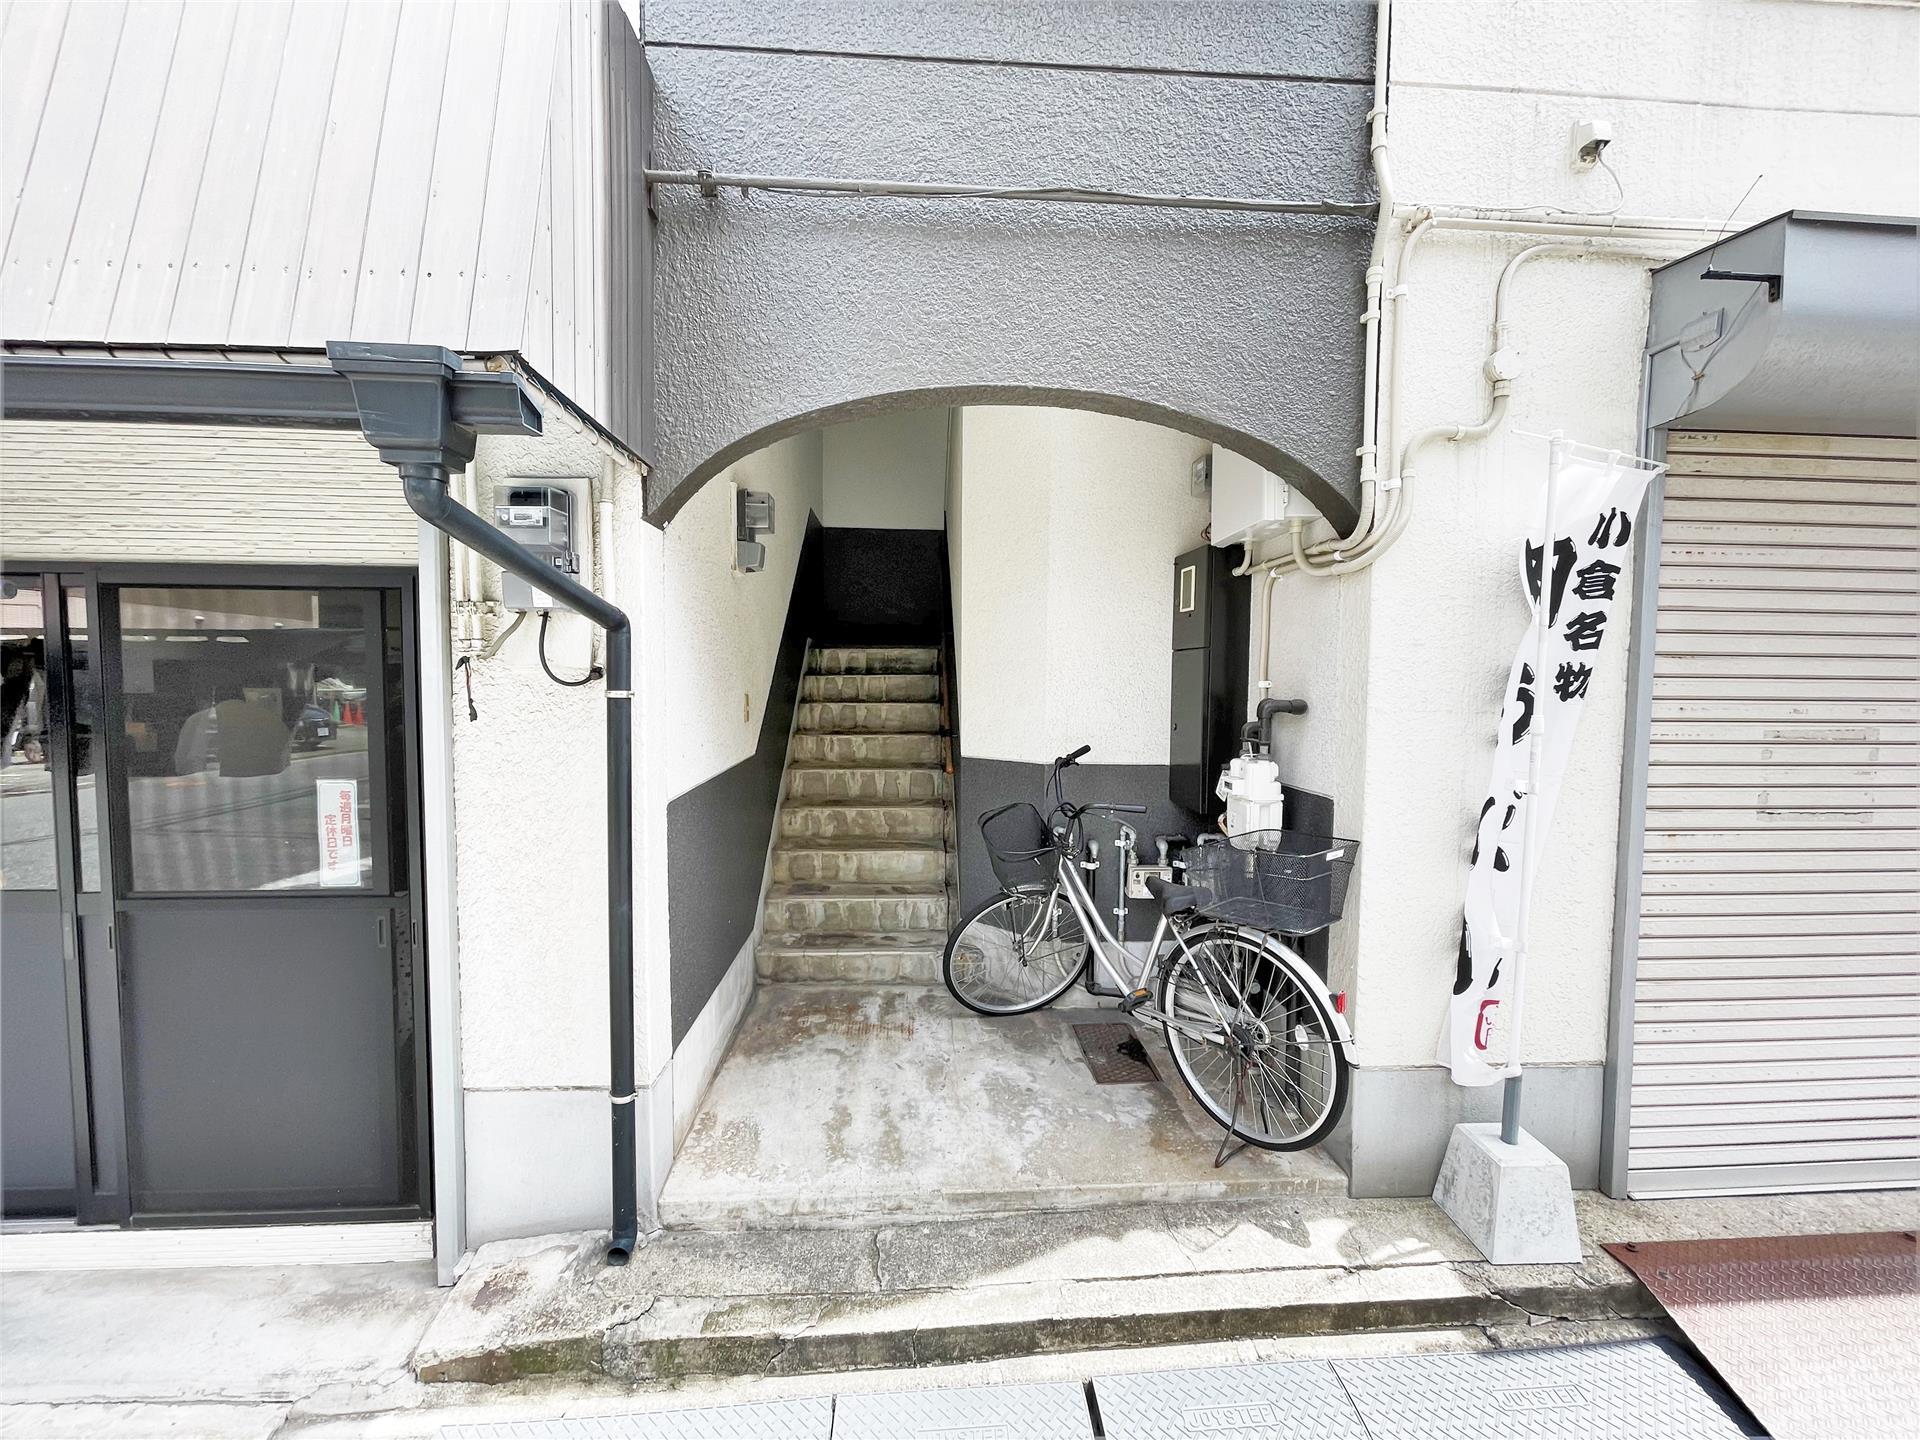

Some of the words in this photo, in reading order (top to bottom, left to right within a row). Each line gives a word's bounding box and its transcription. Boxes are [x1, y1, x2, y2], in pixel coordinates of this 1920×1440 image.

[1553, 506, 1632, 703] 小倉名物
[325, 814, 338, 871] 定休日です
[339, 790, 353, 847] 毎週月曜日
[1189, 1406, 1272, 1429] JOYSTEP
[1502, 1388, 1579, 1408] JOYSTEP
